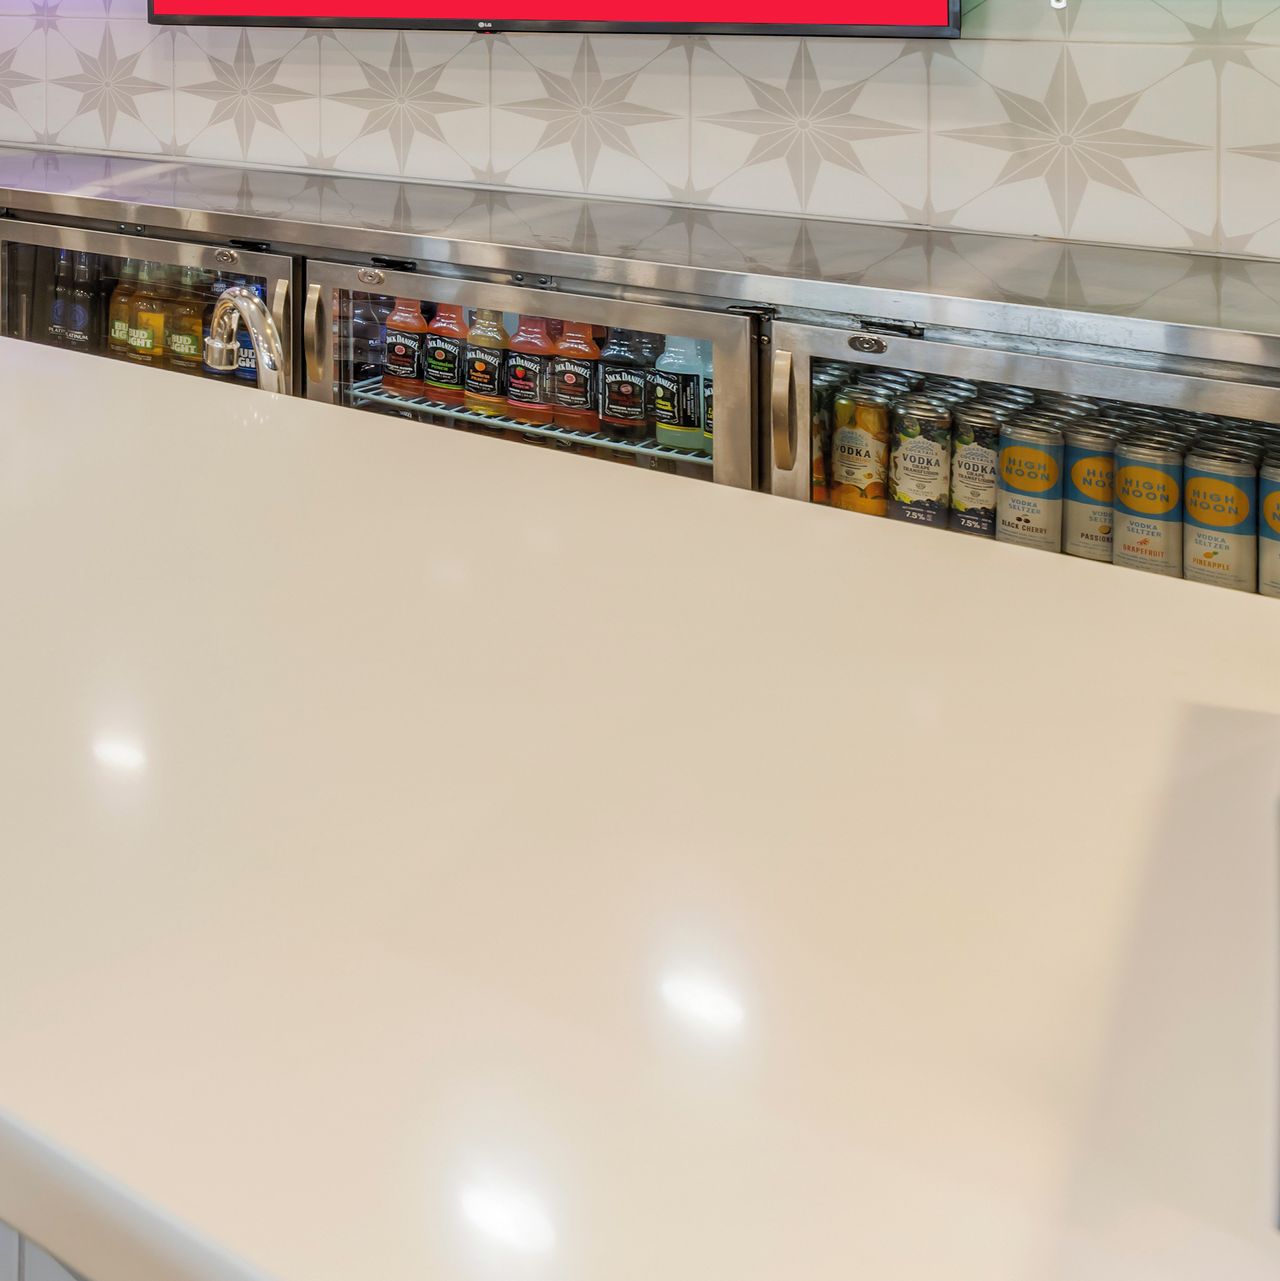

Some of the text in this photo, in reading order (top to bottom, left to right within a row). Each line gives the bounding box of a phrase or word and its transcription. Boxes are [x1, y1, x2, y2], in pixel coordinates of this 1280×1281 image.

[115, 321, 128, 332] BU
[111, 328, 128, 340] LIG
[239, 347, 257, 358] UD
[436, 339, 459, 355] DANIEL'S
[476, 350, 500, 366] DANIEL'S
[516, 356, 541, 373] DANIEL'S
[565, 362, 591, 378] DANIEL'S
[605, 373, 621, 383] JACK
[902, 453, 940, 467] VODKA
[1008, 457, 1047, 471] HIGH
[957, 460, 997, 475] VODKA
[1005, 466, 1050, 480] NOON
[1087, 468, 1113, 480] HIG
[1123, 478, 1166, 492] HIGH
[1121, 487, 1170, 503] NOON
[1192, 489, 1235, 504] HIGH
[1008, 503, 1041, 514] SELTZER
[1011, 499, 1038, 508] VODKA
[1190, 499, 1239, 515] NOON
[905, 510, 926, 521] 7.5%
[960, 518, 981, 529] 7.5%
[1001, 519, 1047, 535] BLACK CHERRY
[1129, 520, 1158, 531] VODKA
[1126, 526, 1162, 538] SELTZER
[1196, 532, 1226, 544] VODKA
[1122, 544, 1165, 558] GRAPEFRUIT
[1194, 538, 1230, 551] SELTZER
[1192, 557, 1230, 571] PINEAPPLE
